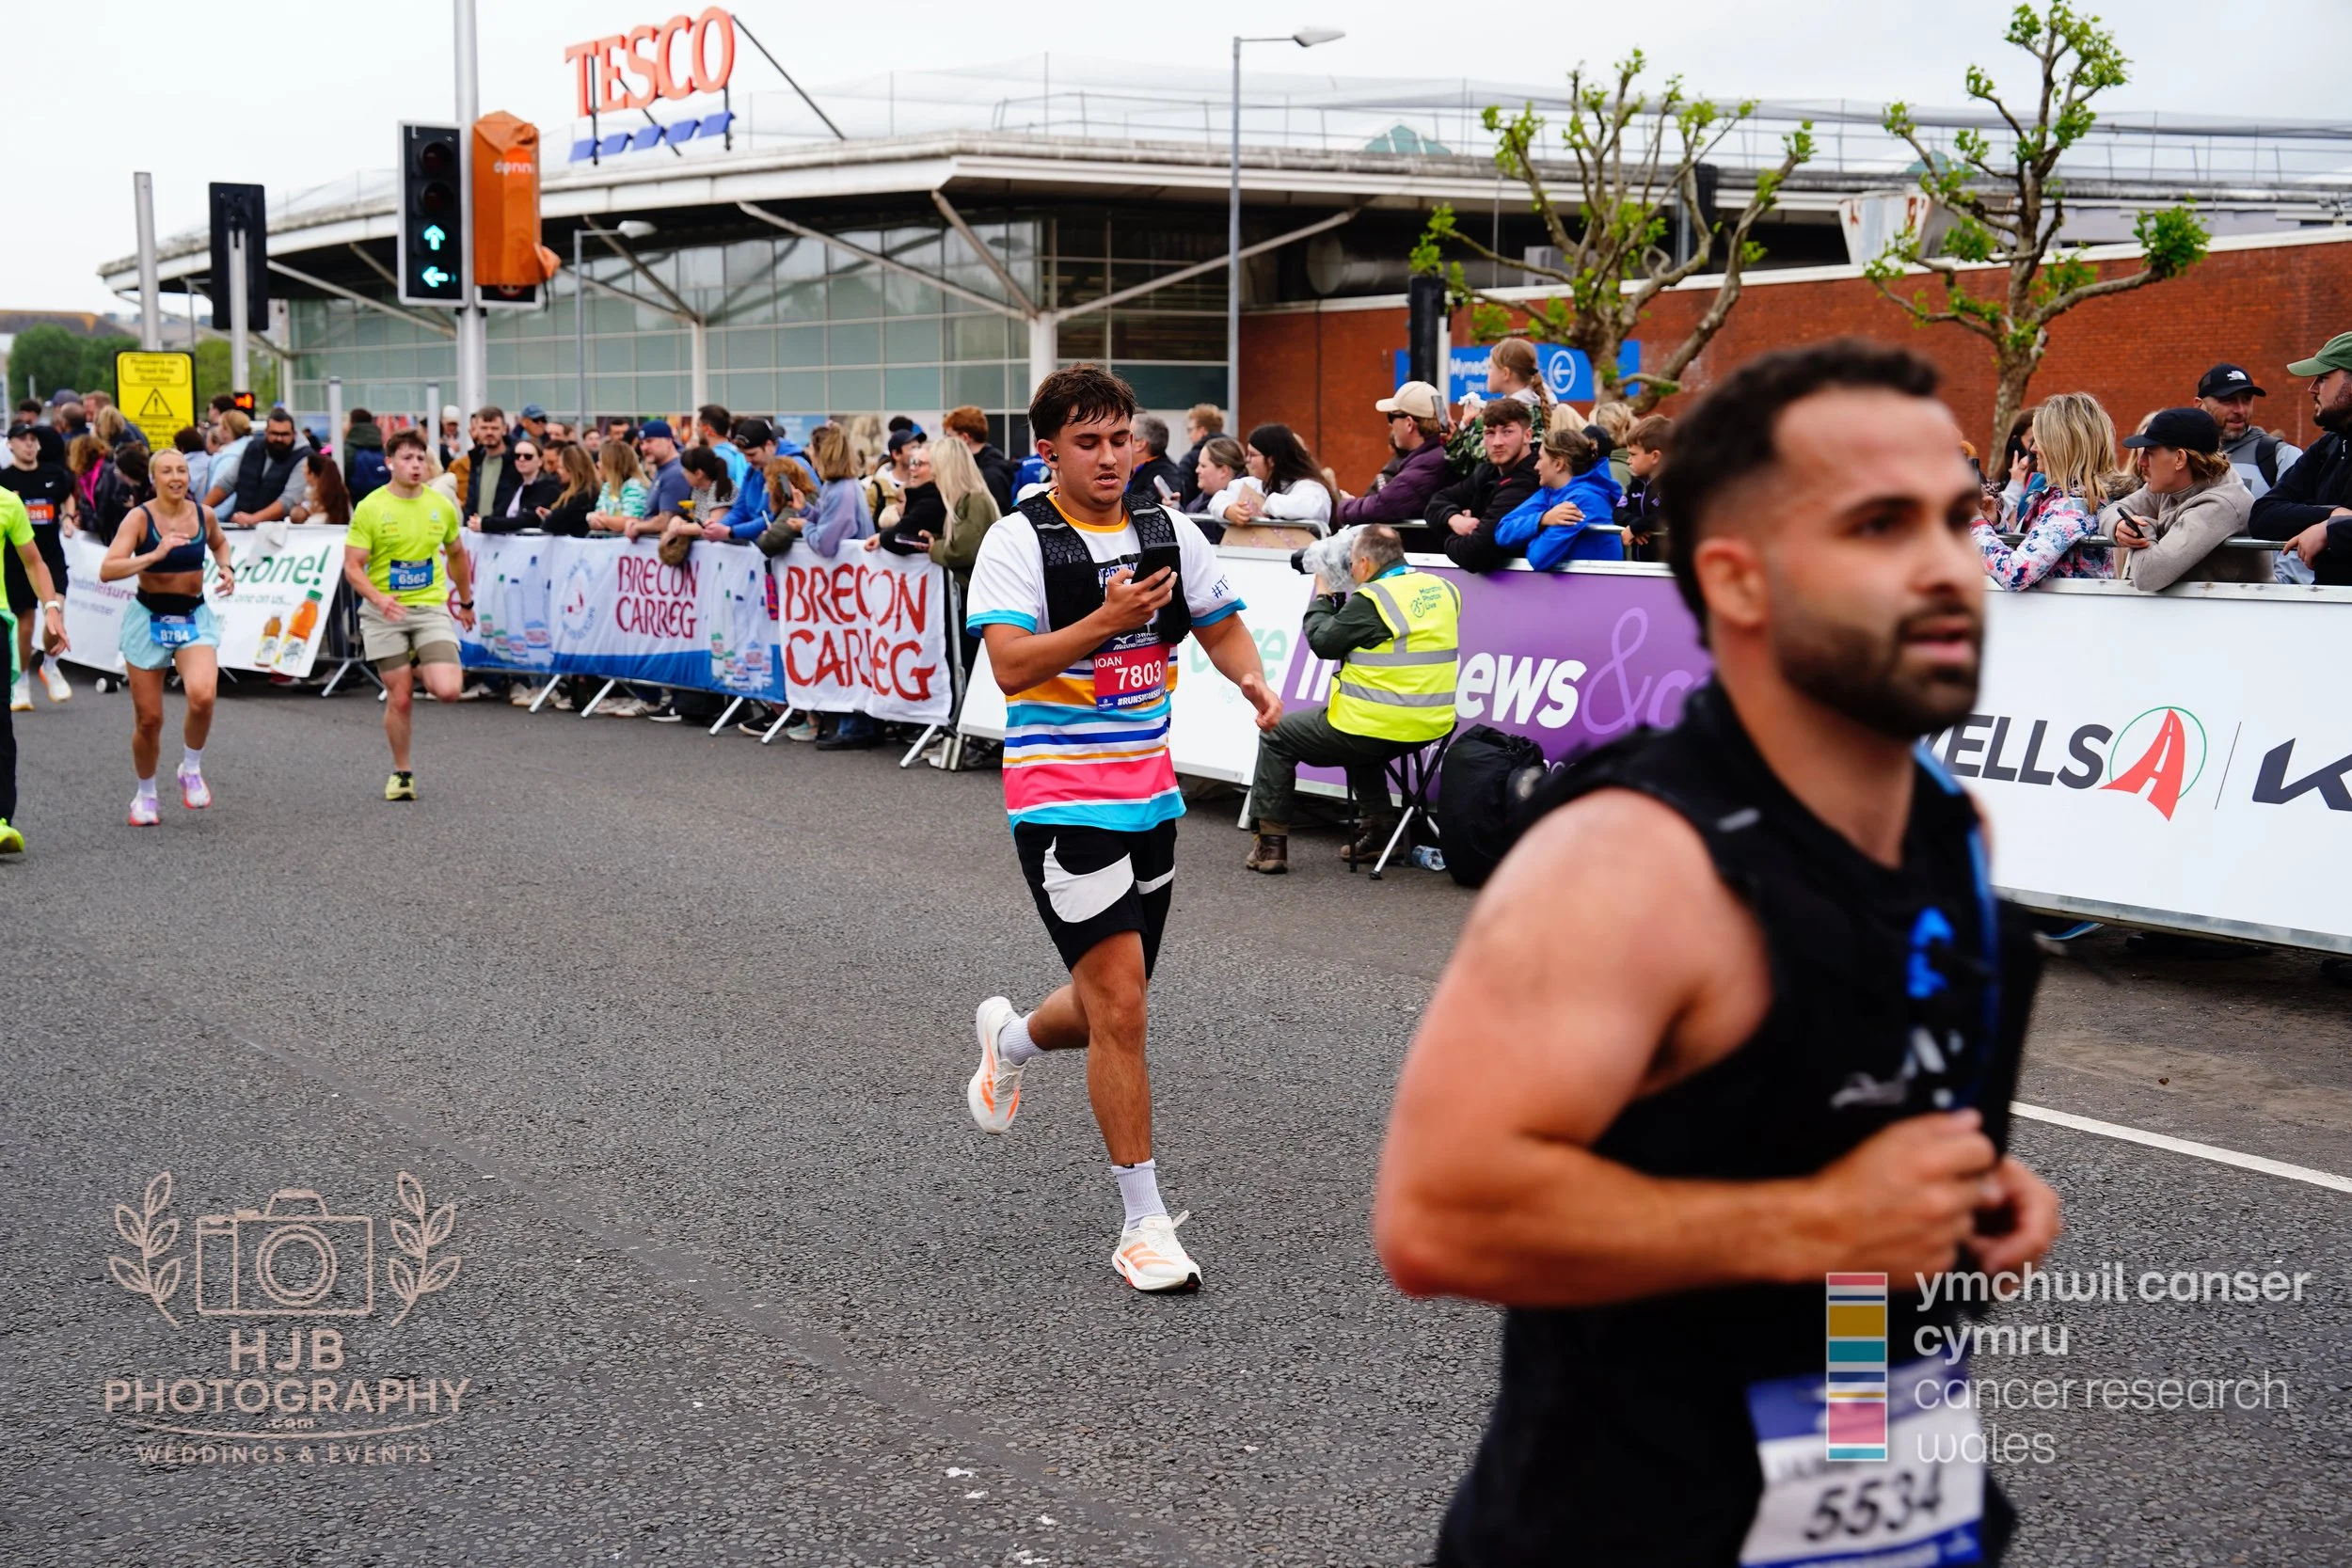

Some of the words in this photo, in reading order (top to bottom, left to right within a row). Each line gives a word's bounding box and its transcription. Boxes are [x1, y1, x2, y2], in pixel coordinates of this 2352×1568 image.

[564, 6, 736, 119] TESCO
[618, 556, 700, 598] BRECON
[786, 562, 929, 635] BRECON
[616, 595, 697, 640] CARREG
[1424, 602, 1438, 610] Live
[1095, 656, 1122, 669] IOAN
[1115, 659, 1162, 690] 7803
[1922, 713, 2114, 790] ELLS
[1803, 1461, 1944, 1542] 5534
